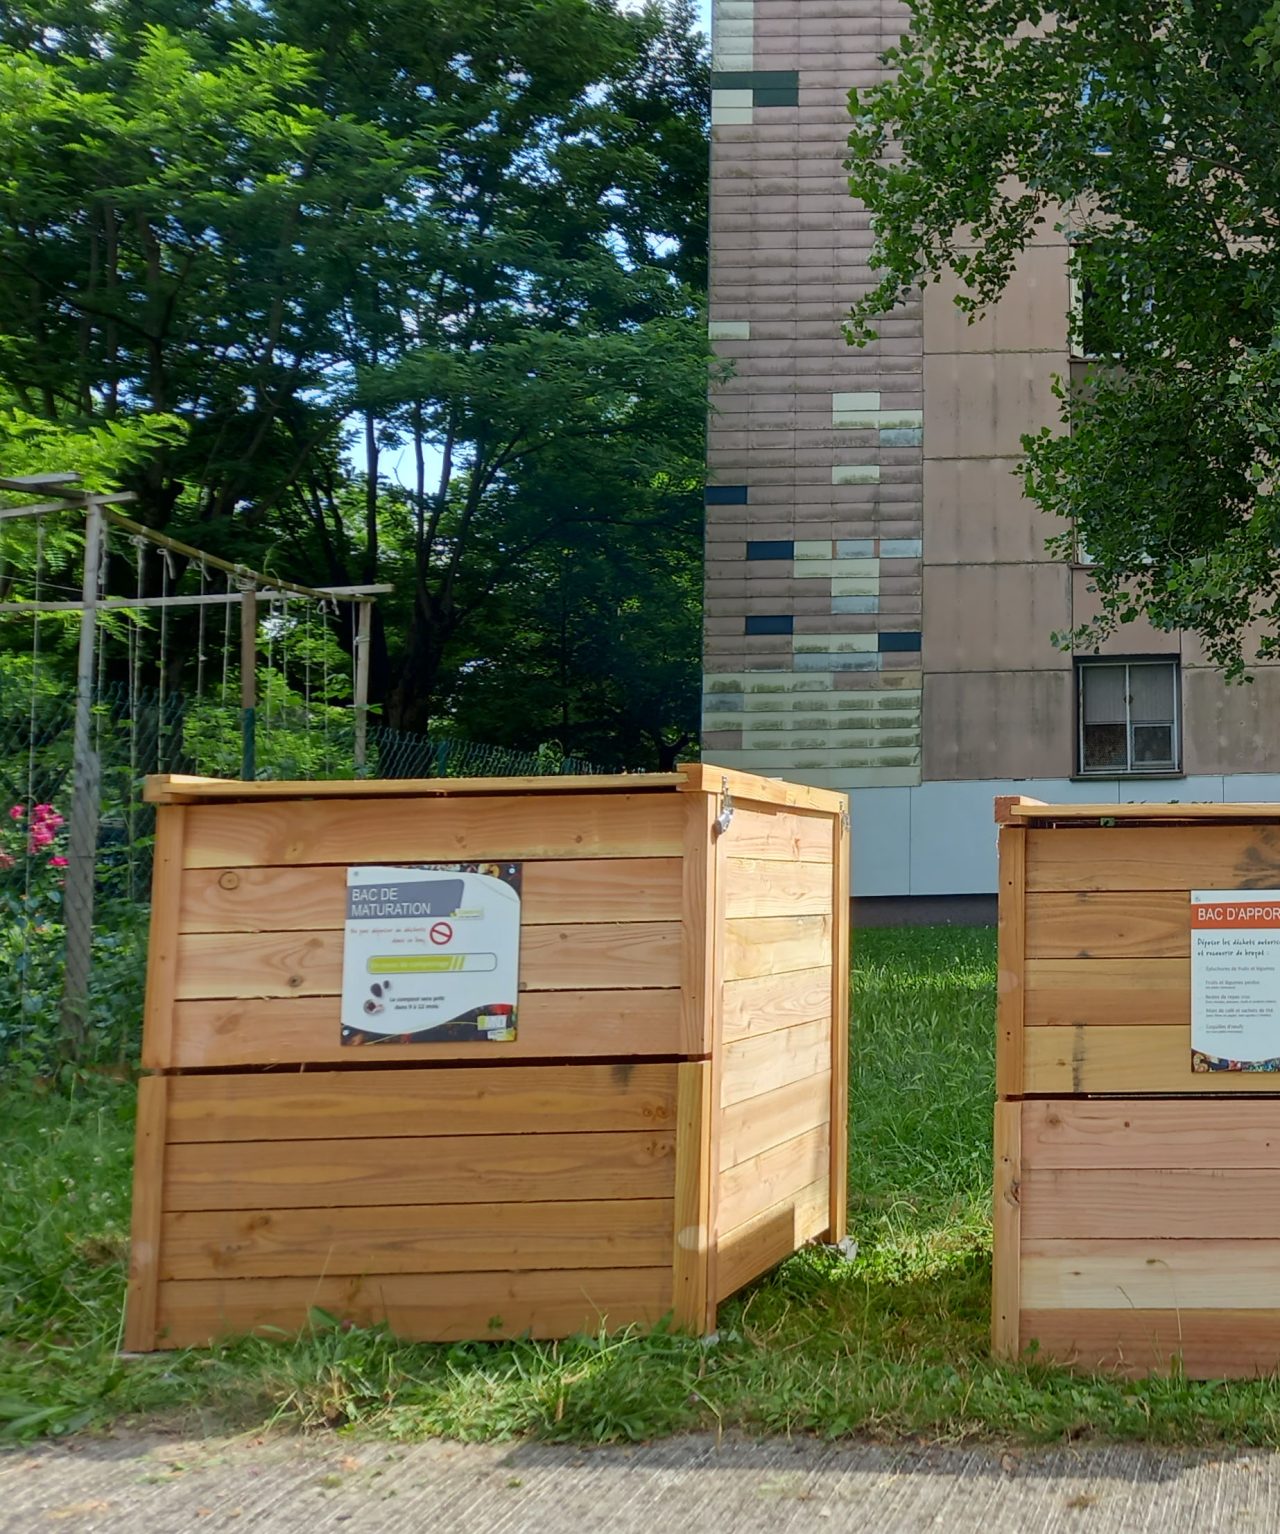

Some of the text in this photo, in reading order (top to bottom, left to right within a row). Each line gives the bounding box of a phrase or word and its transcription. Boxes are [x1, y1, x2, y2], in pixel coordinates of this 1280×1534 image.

[352, 888, 398, 901] BAC DE
[351, 902, 431, 916] MATURATION
[1198, 908, 1223, 920] BAC
[1197, 938, 1220, 948] Déposer
[1222, 938, 1230, 946] les
[1233, 938, 1255, 946] déchets
[1245, 949, 1264, 959] broyat
